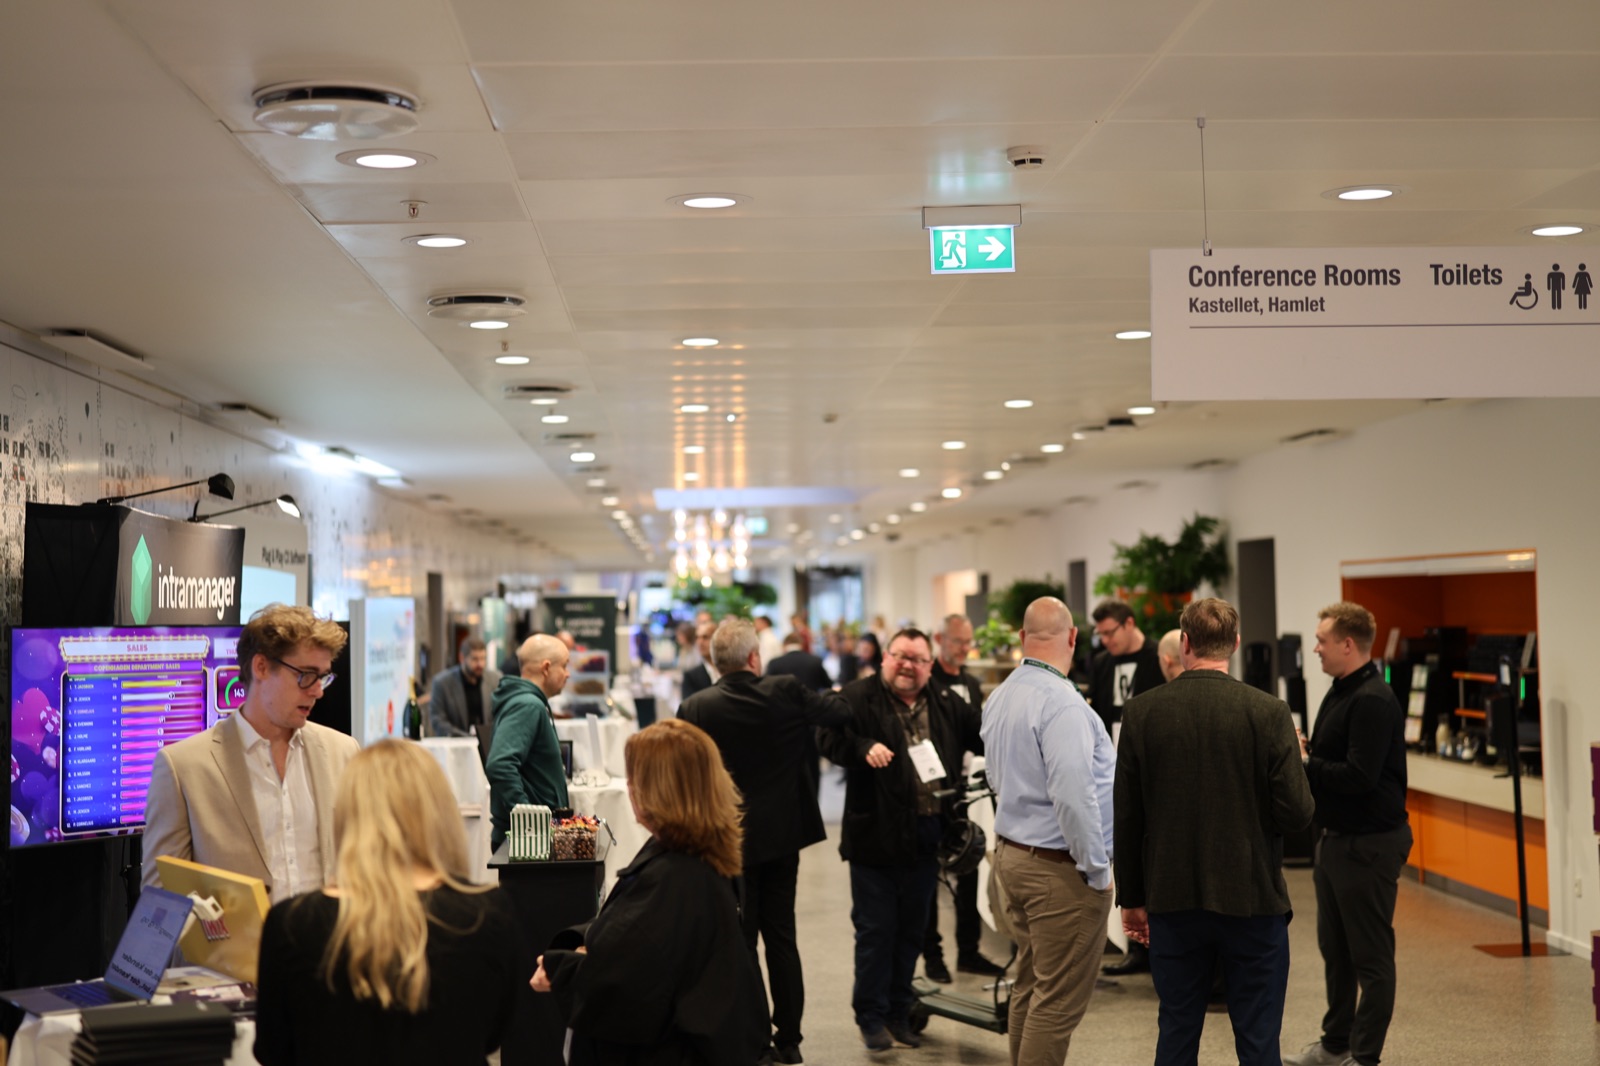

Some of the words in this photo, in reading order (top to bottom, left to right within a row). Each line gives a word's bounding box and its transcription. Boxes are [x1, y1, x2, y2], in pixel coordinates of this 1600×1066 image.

[1188, 265, 1317, 287] Conference
[1324, 264, 1401, 286] Rooms
[1429, 264, 1503, 286] Toilets
[1188, 297, 1264, 315] Kastellet,
[1268, 296, 1326, 313] Hamlet
[158, 563, 236, 621] intramanager
[126, 644, 148, 652] SALES
[93, 663, 131, 672] COPENHAGEN
[131, 663, 164, 671] DEPARTMENT
[234, 688, 245, 698] 143
